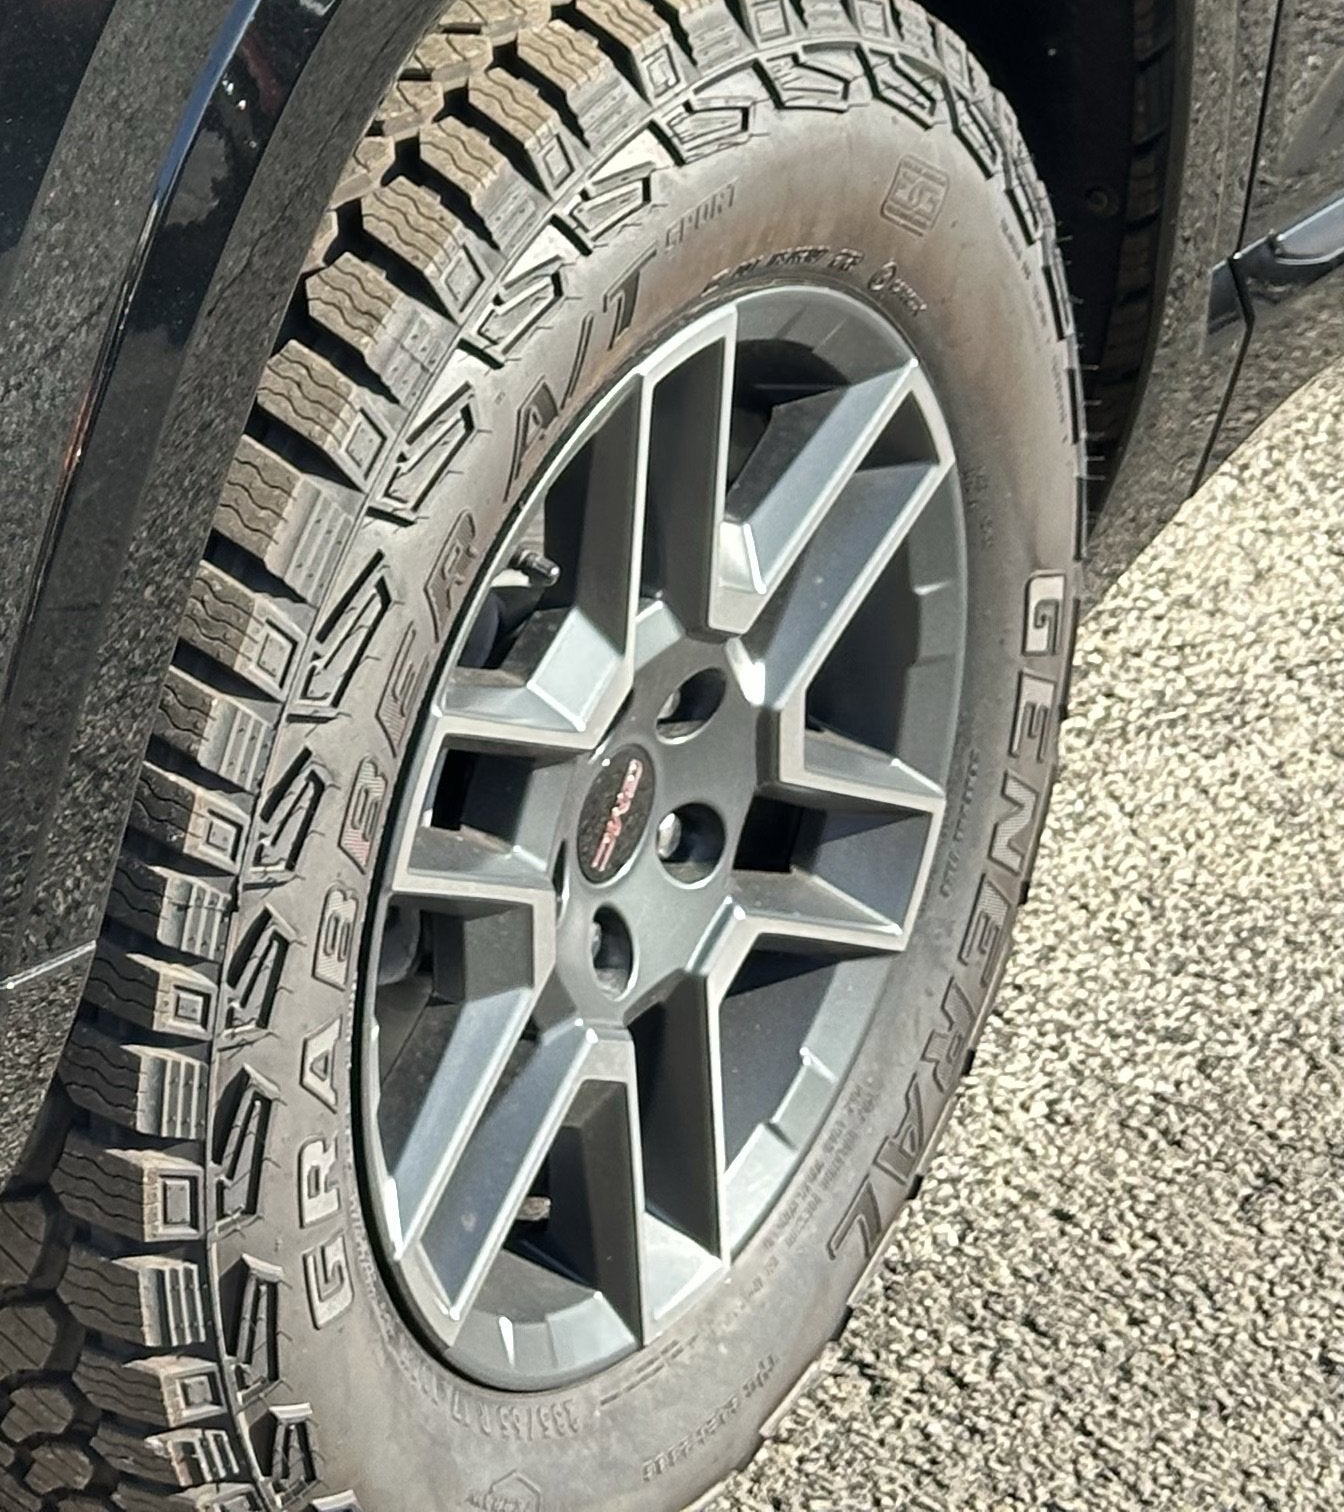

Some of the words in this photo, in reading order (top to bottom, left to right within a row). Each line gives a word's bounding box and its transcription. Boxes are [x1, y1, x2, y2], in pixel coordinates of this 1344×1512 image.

[297, 508, 477, 1330] GRABBER
[504, 246, 657, 502] A/T
[591, 759, 643, 872] GMC
[826, 569, 1066, 1261] GENERAL
